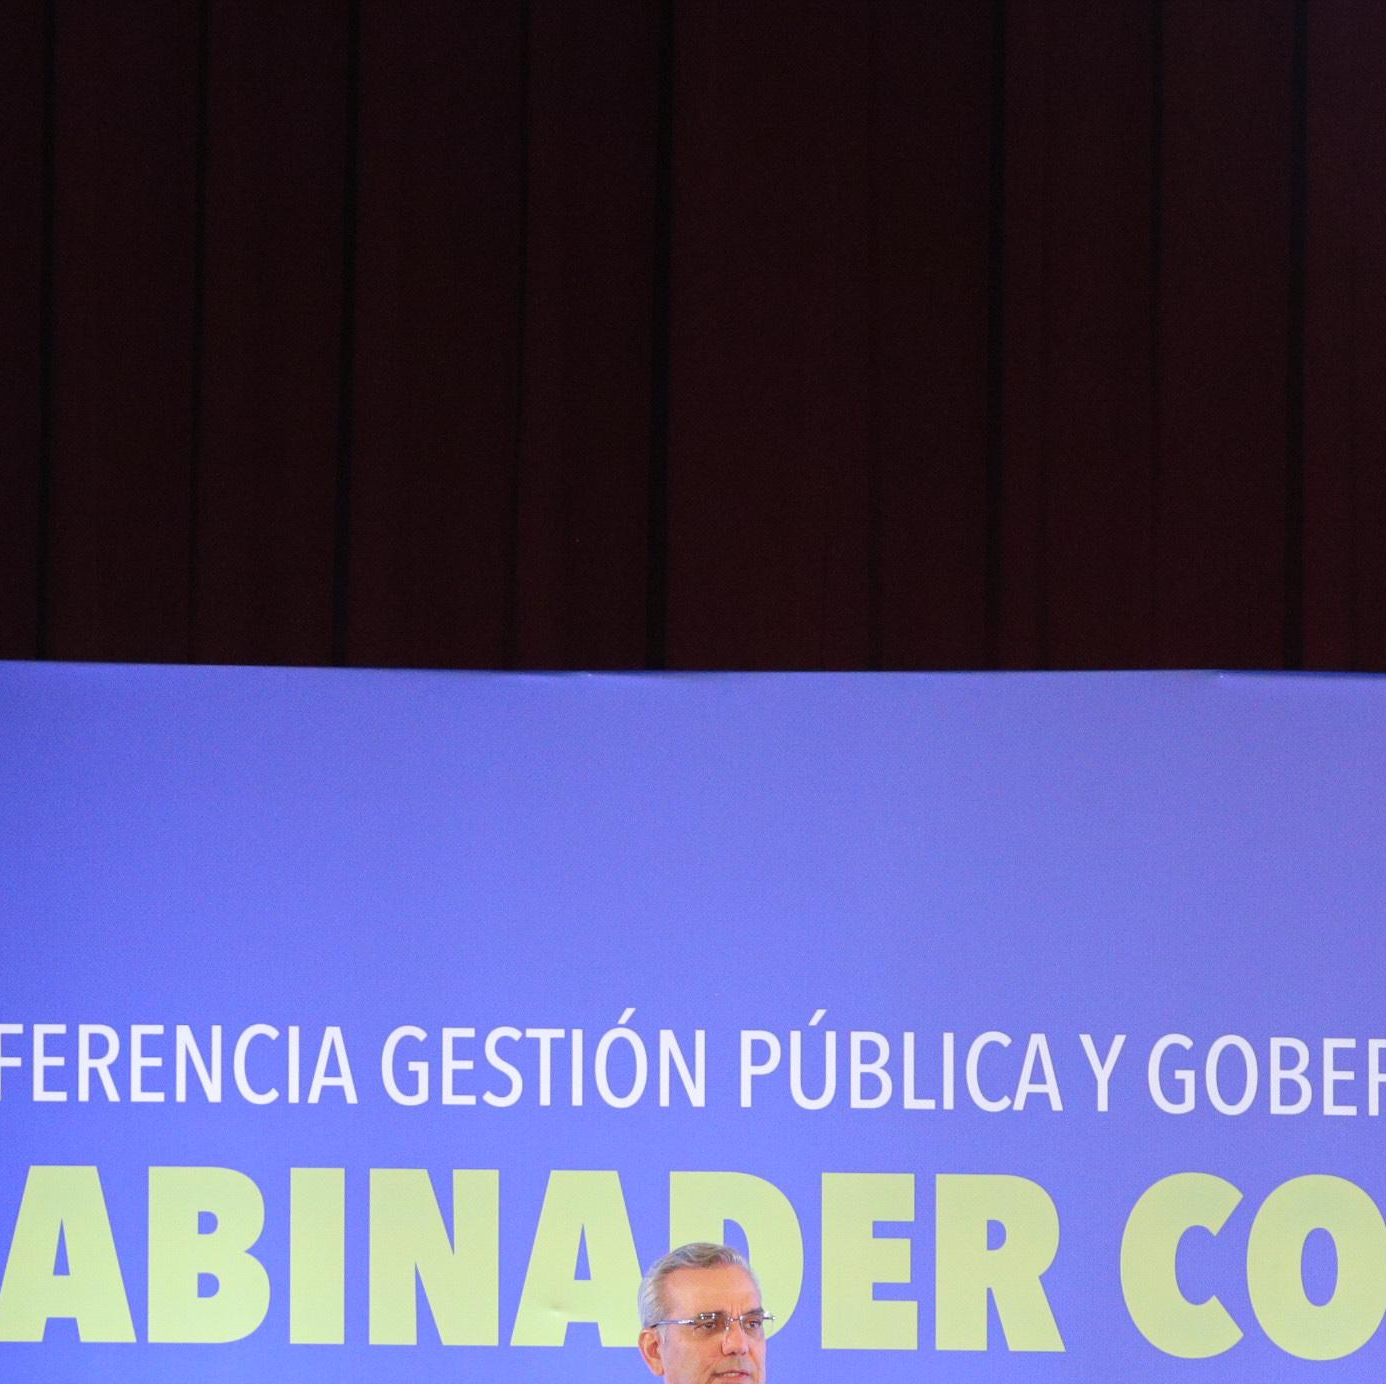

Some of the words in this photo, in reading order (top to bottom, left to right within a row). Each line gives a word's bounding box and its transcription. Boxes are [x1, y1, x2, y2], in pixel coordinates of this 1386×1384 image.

[381, 1008, 706, 1109] GESTIÓN
[740, 1009, 1063, 1112] PÚBLICA
[1079, 1034, 1127, 1112] Y
